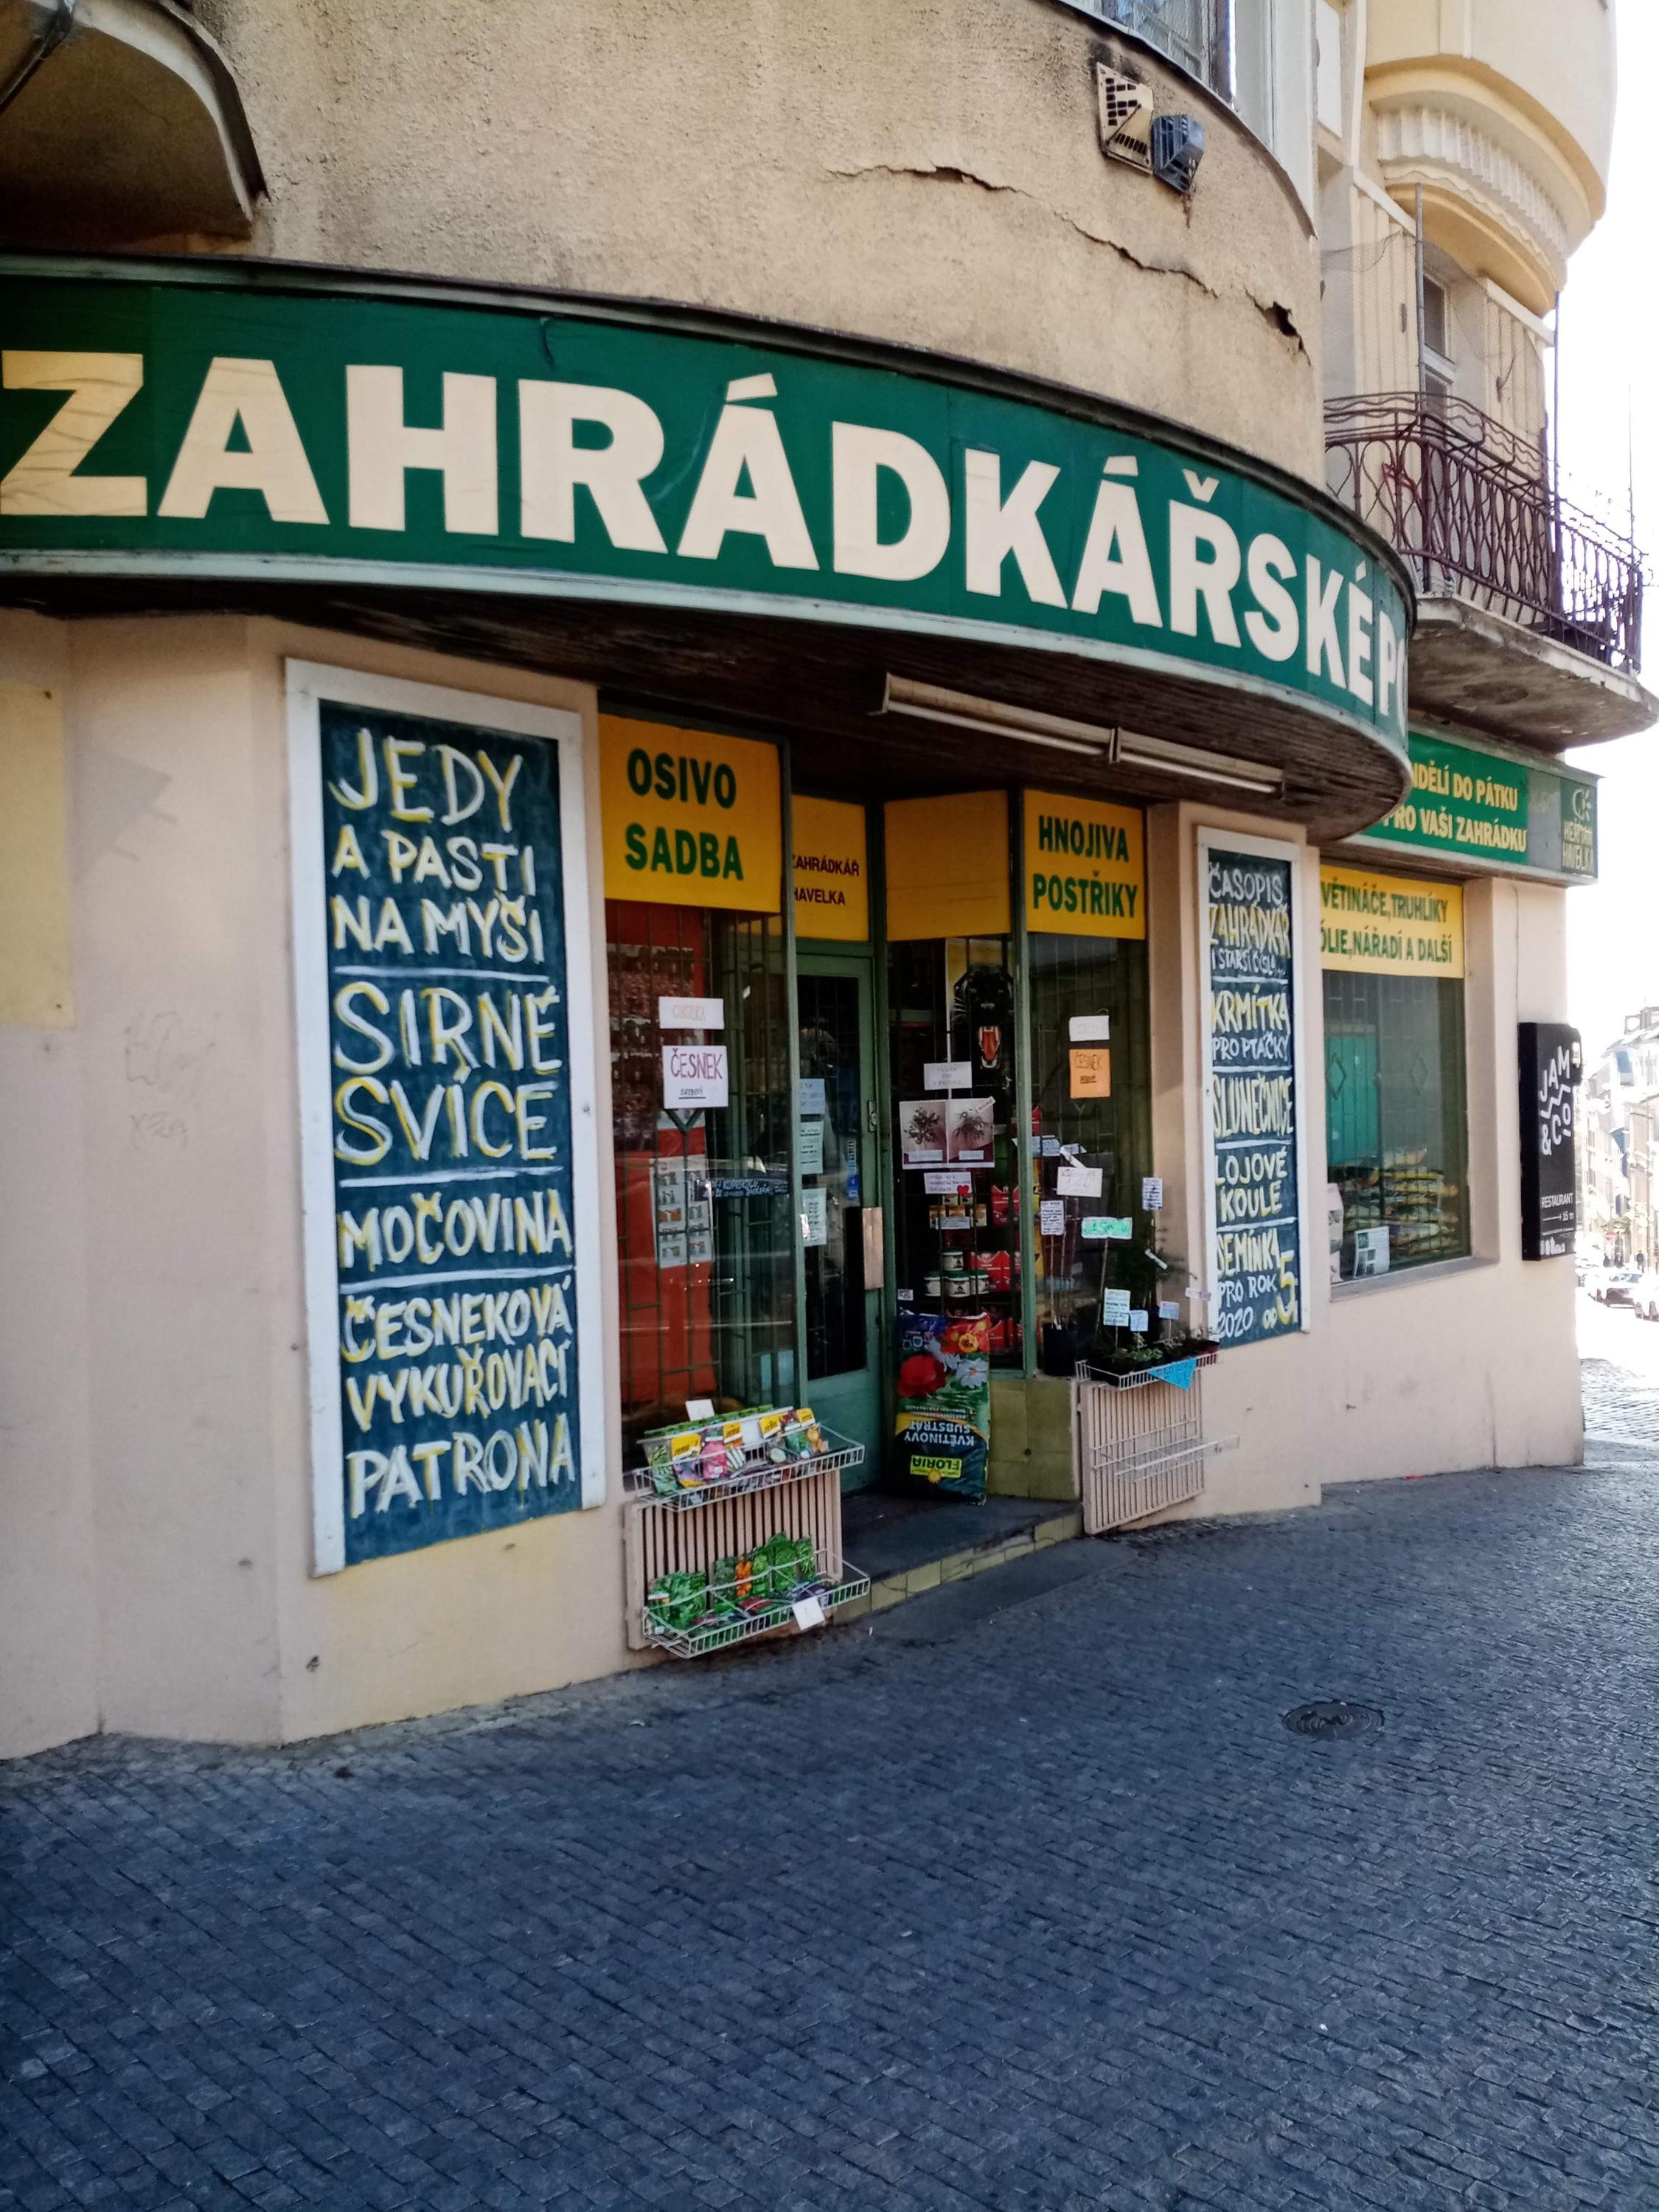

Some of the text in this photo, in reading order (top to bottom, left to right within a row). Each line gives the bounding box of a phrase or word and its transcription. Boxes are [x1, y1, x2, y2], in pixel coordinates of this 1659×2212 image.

[0, 349, 1374, 706] ZAHRÁDKÁŘSKÉ
[328, 728, 524, 833] JEDY
[627, 748, 737, 808] OSIVO
[1453, 773, 1472, 801] DO
[1476, 776, 1518, 812] PÁTKU
[625, 823, 744, 881] SADBA
[1038, 815, 1129, 863] HNOJIVA
[1420, 805, 1453, 840] VAŠI
[1456, 817, 1527, 852] ZAHRÁDKU
[332, 824, 536, 896] A PASTI
[1208, 862, 1284, 905] ČASOPIS
[1033, 869, 1138, 918] POSTŘIKY
[331, 888, 545, 964] NA MYŠI
[1208, 900, 1290, 958] ZAHRÁDKÁŘ
[1406, 936, 1414, 961] A
[1418, 933, 1453, 964] DALŠÍ
[1211, 983, 1291, 1034] KRMÍTKA
[671, 1048, 723, 1079] ČESNEK
[1212, 1036, 1239, 1060] PRO
[1540, 1045, 1570, 1102] JAM
[1213, 1072, 1293, 1138] SLUNEČNICE
[1542, 1123, 1552, 1155] &
[1216, 1146, 1287, 1186] LOJOVÉ
[1221, 1180, 1283, 1222] KOULE
[1542, 1192, 1573, 1209] RESTAURANT
[338, 1189, 573, 1271] MOČOVINA
[1217, 1228, 1280, 1276] SEMÍNKA
[1218, 1279, 1244, 1308] PRO
[1247, 1273, 1278, 1298] ROK
[341, 1275, 574, 1363] ČESNEKOVÁ
[1217, 1307, 1253, 1338] 2020
[347, 1338, 572, 1432] VYKUŘOVACÍ
[908, 1420, 971, 1434] SUBSTRÁT
[345, 1412, 575, 1519] PATRONA
[911, 1455, 960, 1472] FLORIA
